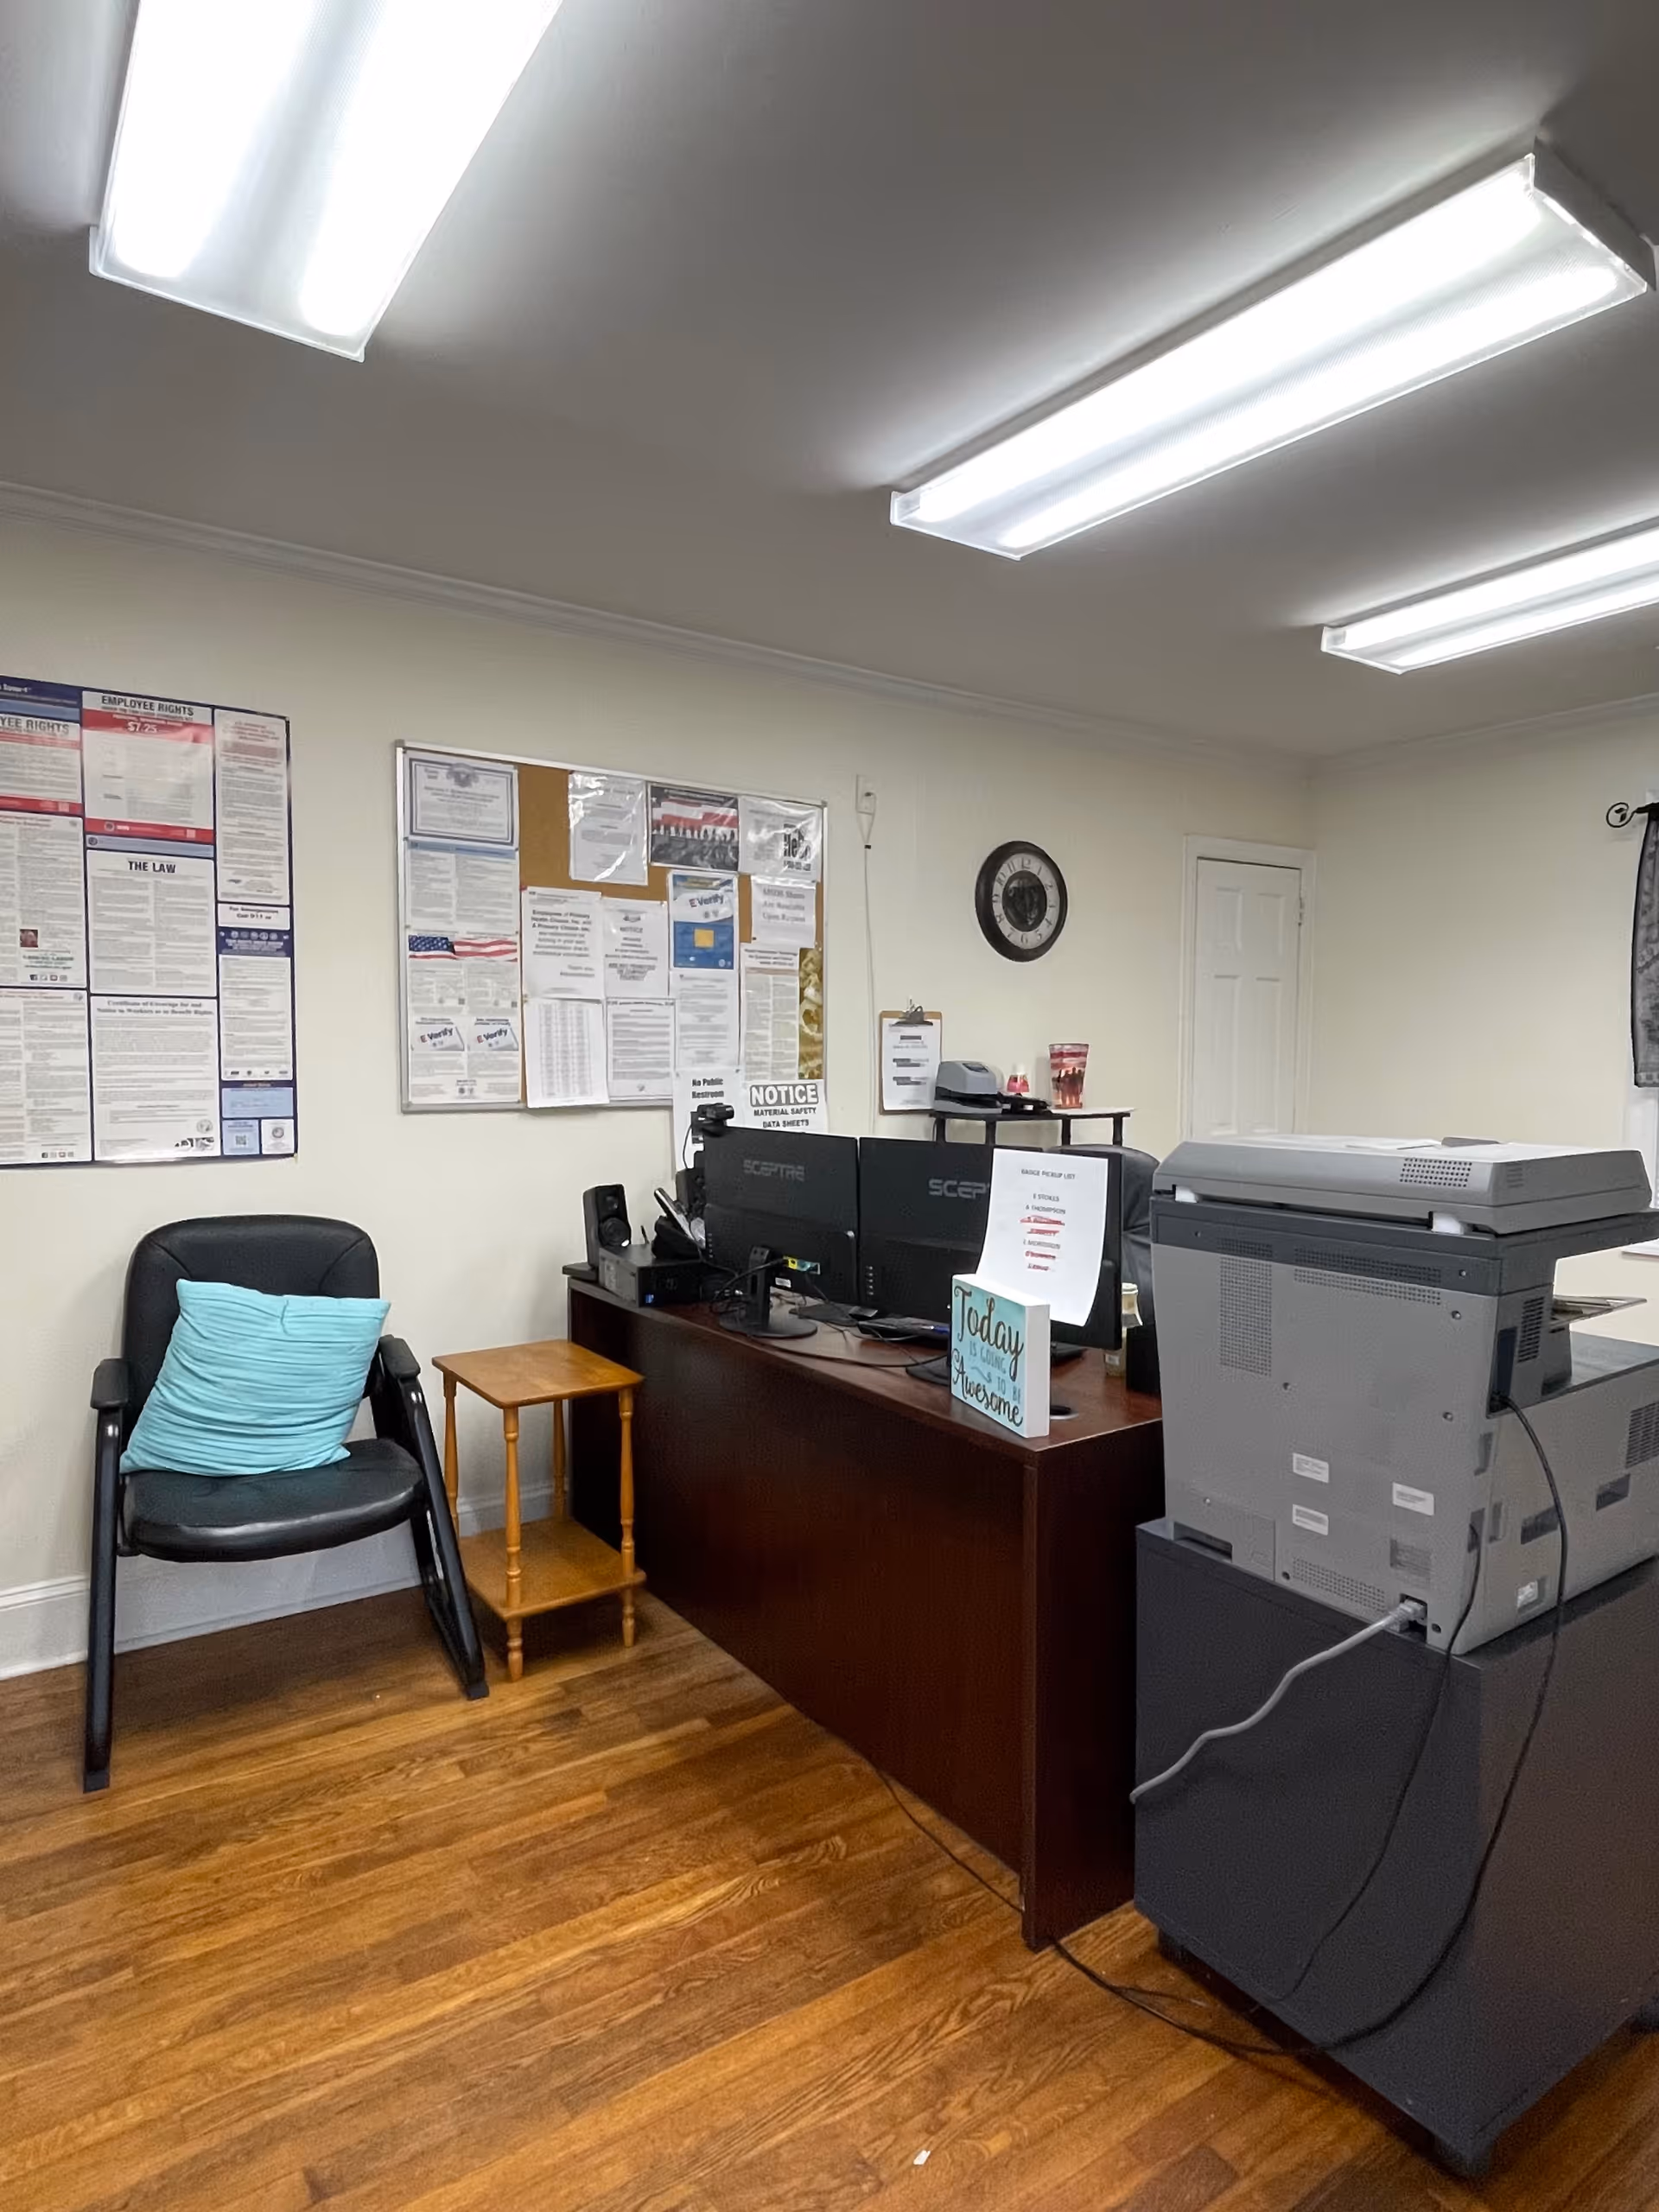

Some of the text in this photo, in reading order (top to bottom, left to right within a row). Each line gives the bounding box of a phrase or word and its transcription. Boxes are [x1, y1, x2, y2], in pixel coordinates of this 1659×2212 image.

[101, 696, 155, 711] EMPLOYEE
[158, 702, 194, 716] RIGHTS
[26, 719, 69, 735] RIGHTS
[128, 861, 176, 874] THE LAW
[702, 1077, 724, 1087] Public
[692, 1090, 724, 1099] Restroom
[752, 1084, 818, 1106] NOTICE
[753, 1107, 817, 1117] MATERIAL SAFETY
[763, 1119, 809, 1128] DATA SHEETS
[743, 1159, 805, 1182] SCEPTRE
[929, 1179, 991, 1199] SCEP
[954, 1286, 1024, 1382] Today
[969, 1341, 1007, 1374] IS GOING
[951, 1348, 1023, 1427] Awesome
[997, 1376, 1021, 1405] TO BE
